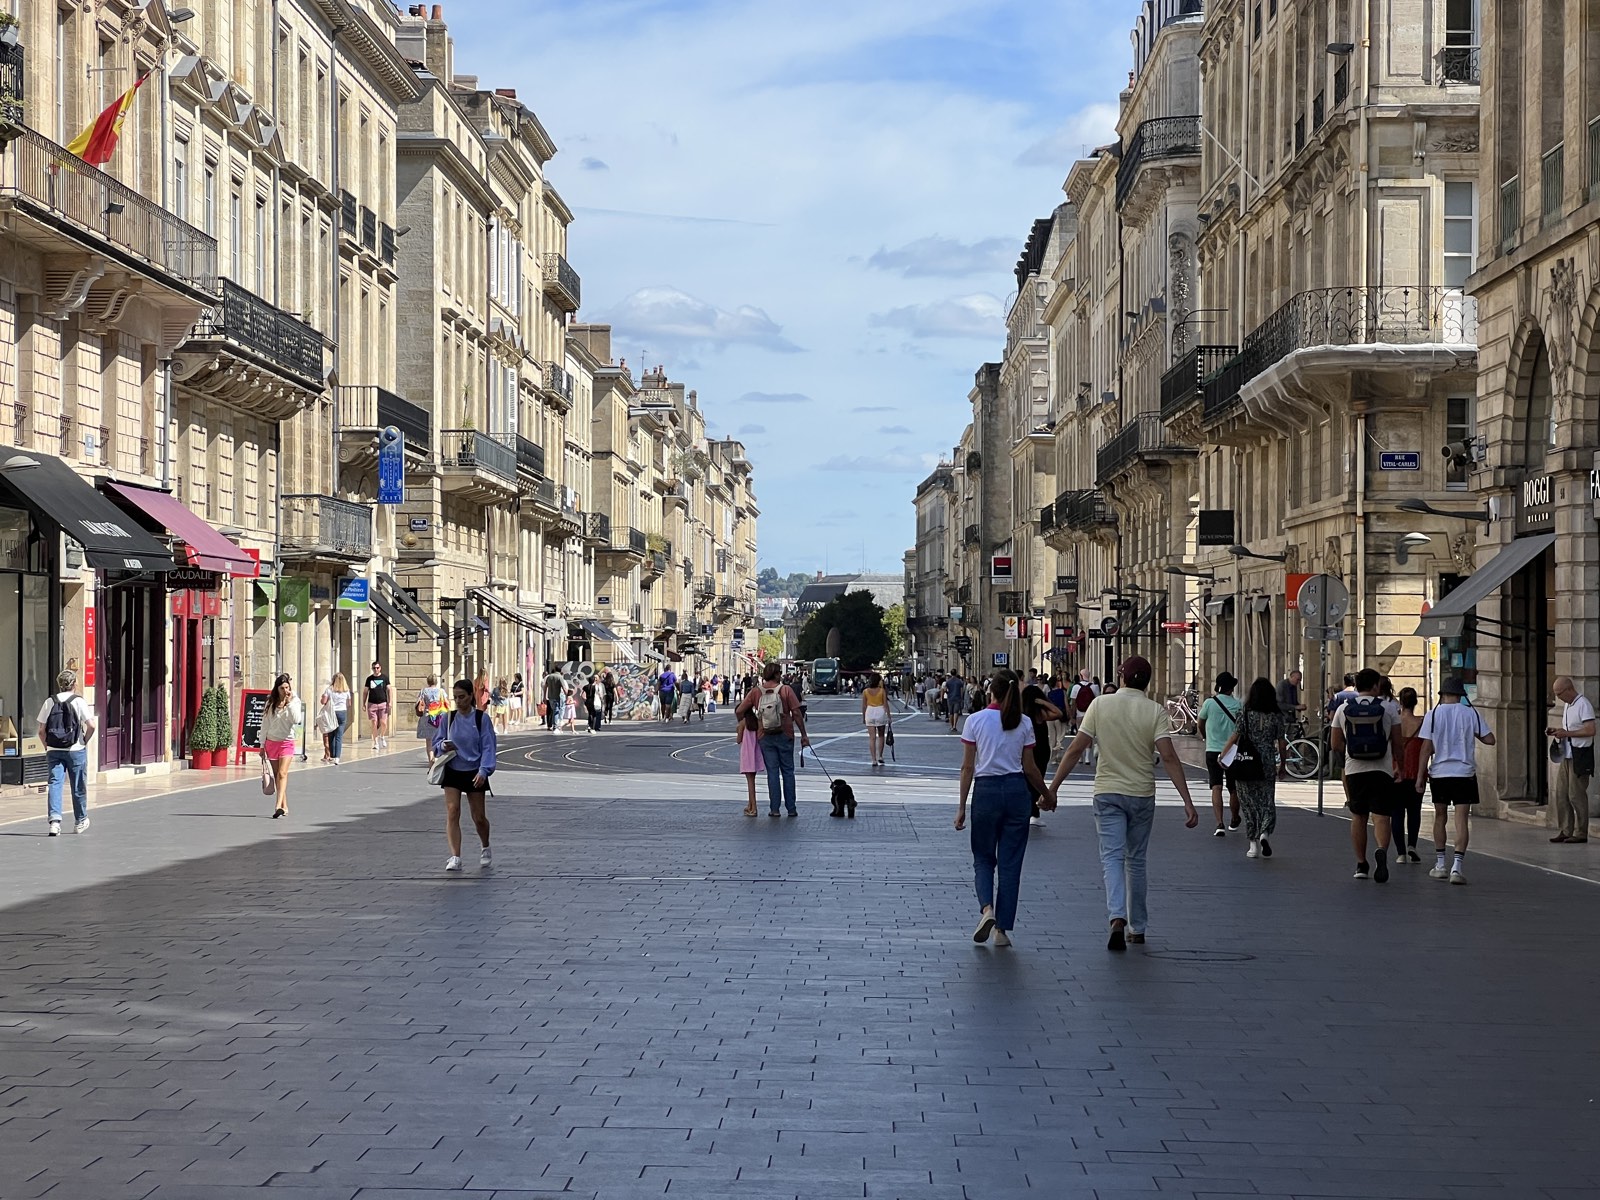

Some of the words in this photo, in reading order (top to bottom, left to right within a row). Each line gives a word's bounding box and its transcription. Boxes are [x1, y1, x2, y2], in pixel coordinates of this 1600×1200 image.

[1523, 475, 1550, 508] BOGGI
[1527, 512, 1549, 523] MILANO
[168, 570, 213, 580] CAUDALIE
